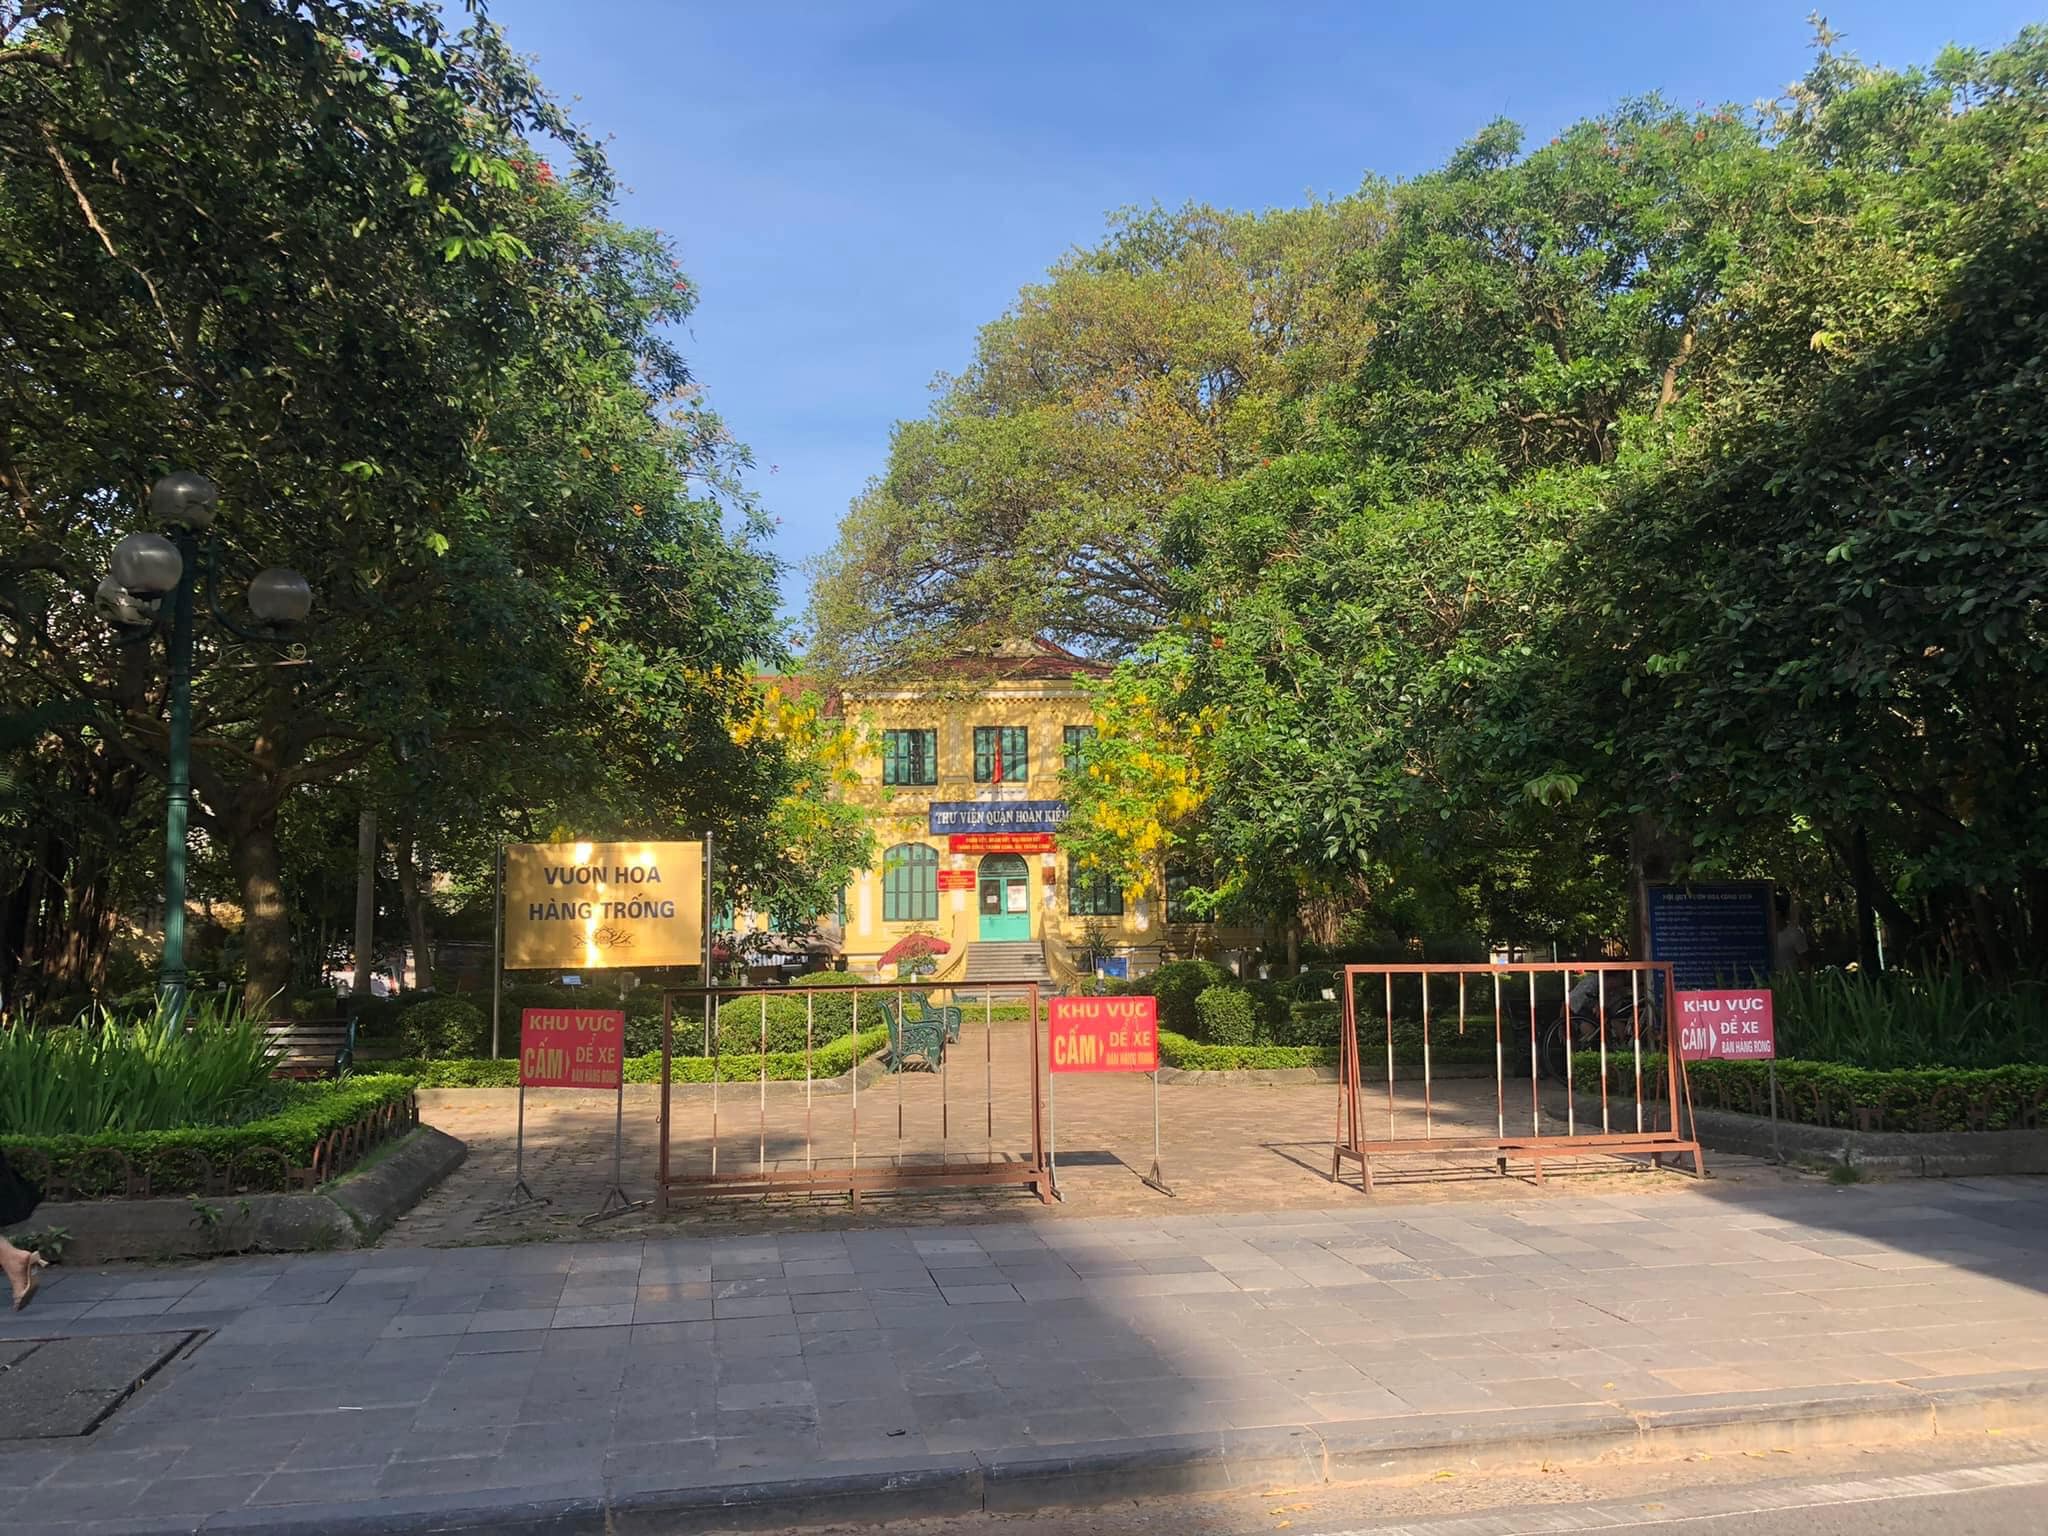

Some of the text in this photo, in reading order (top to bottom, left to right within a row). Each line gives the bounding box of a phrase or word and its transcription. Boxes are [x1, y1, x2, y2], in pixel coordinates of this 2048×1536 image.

[937, 810, 957, 825] THƯ
[960, 807, 985, 827] VIỆN
[986, 807, 1013, 827] QUẬN
[1016, 806, 1043, 823] HOÀN
[615, 866, 661, 883] HOA
[529, 893, 675, 921] HÀNG TRỐNG
[1057, 1003, 1099, 1018] KHU
[1684, 997, 1764, 1014] KHU VỰC
[529, 1015, 615, 1037] KHU VỰC
[1681, 1014, 1759, 1051] CẤM ĐỂ XE
[1055, 1024, 1097, 1065] CẤM
[1134, 1031, 1151, 1047] XE
[524, 1037, 563, 1079] CẤM
[598, 1048, 615, 1063] XE
